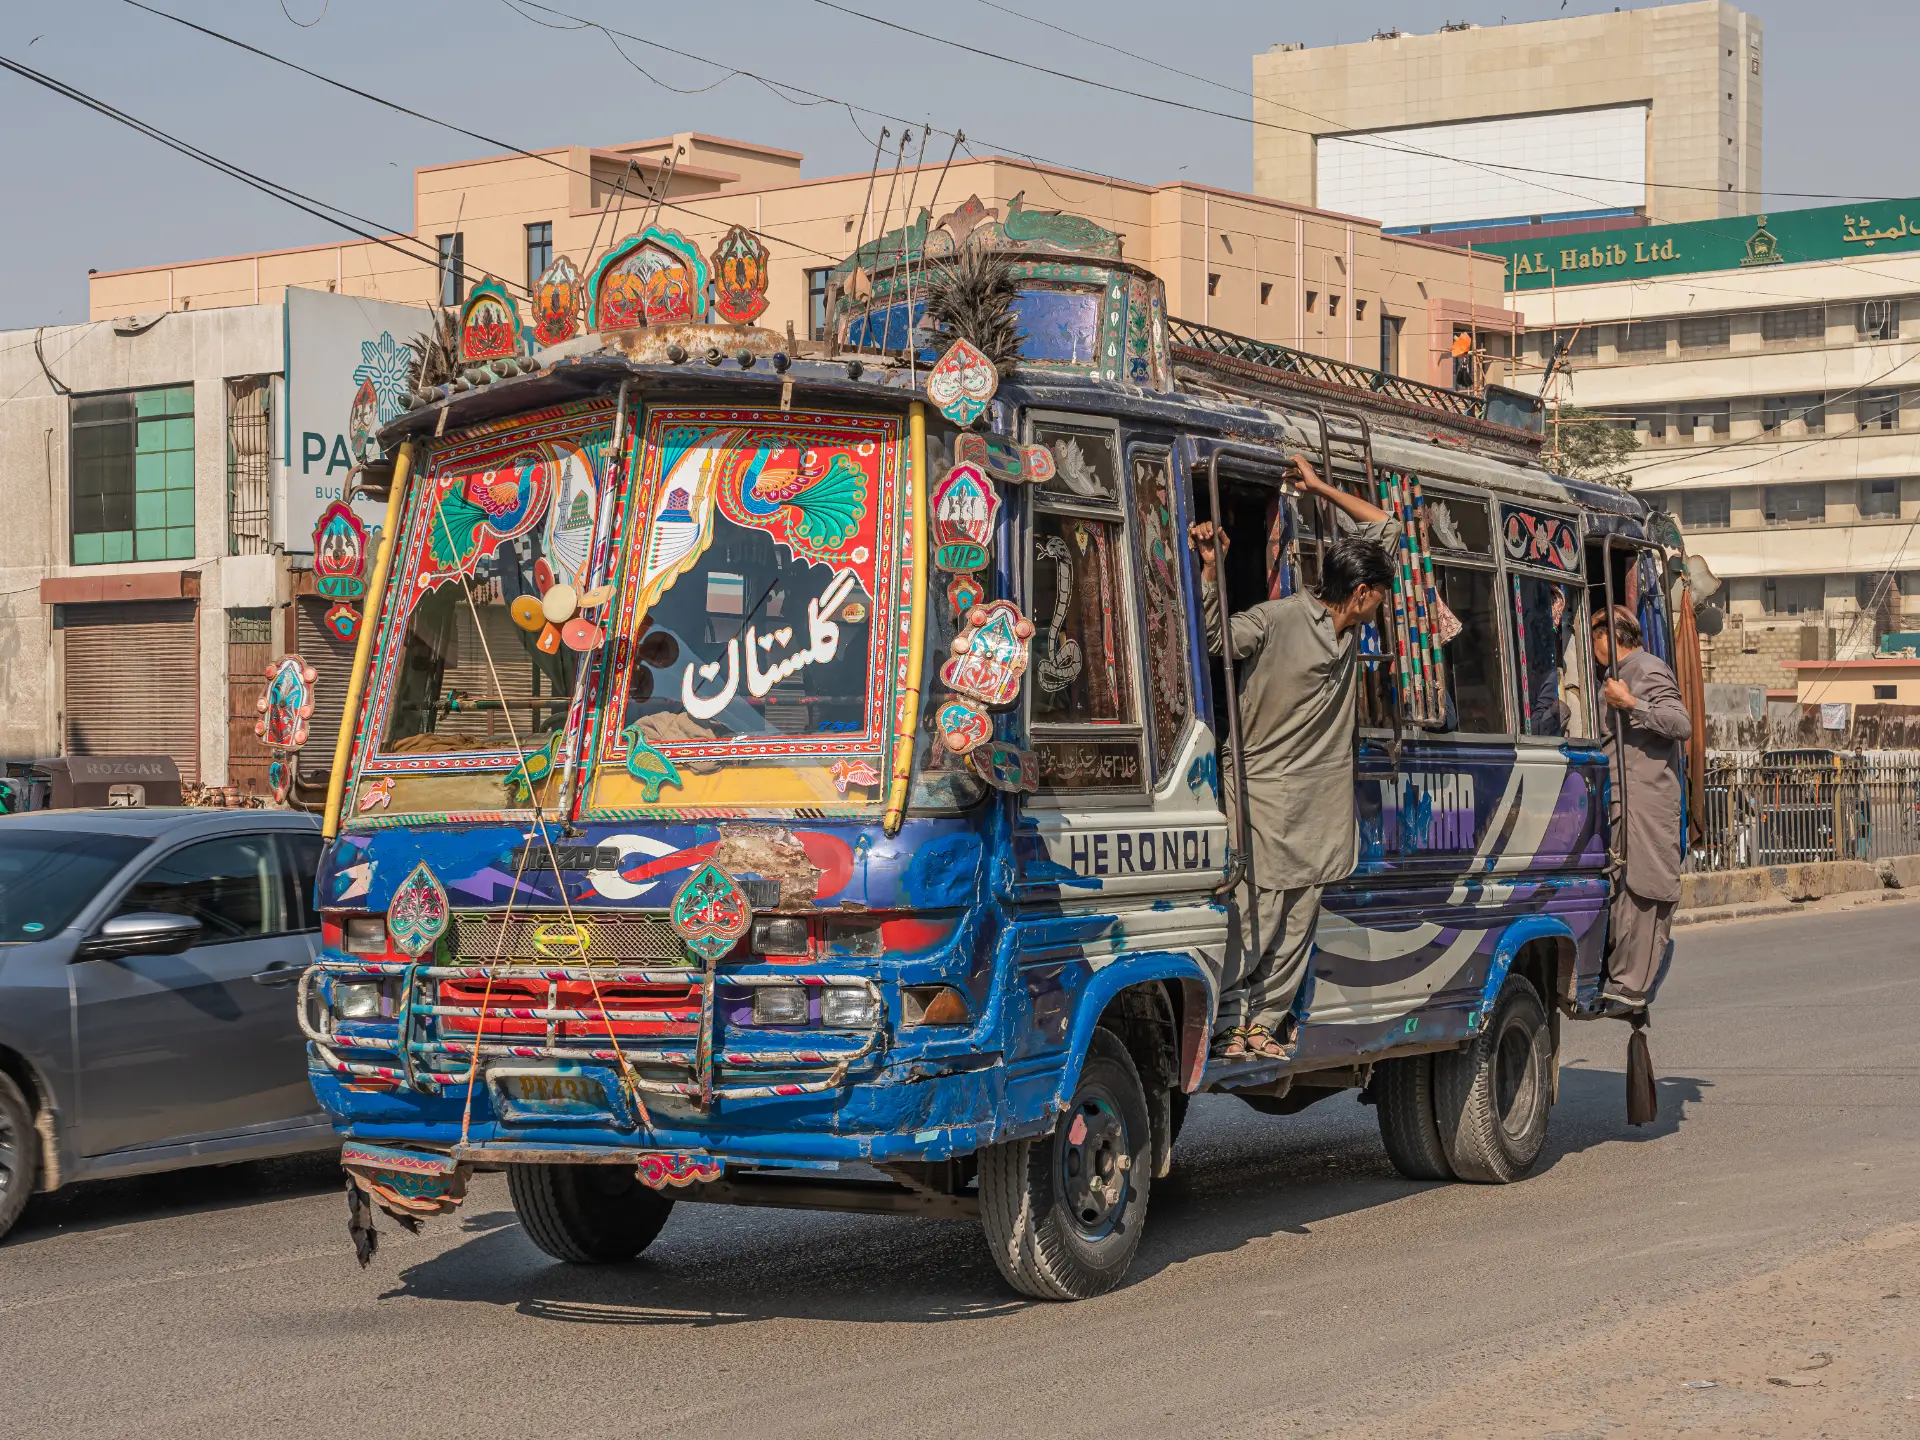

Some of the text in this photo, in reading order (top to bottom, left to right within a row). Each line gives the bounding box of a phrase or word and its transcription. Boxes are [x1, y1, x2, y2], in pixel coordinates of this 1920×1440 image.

[1516, 253, 1549, 275] AL
[1560, 243, 1627, 271] Habib
[1635, 238, 1681, 263] Ltd.
[943, 546, 981, 567] VIP
[321, 579, 360, 595] VIP
[681, 567, 856, 720] گلستان
[818, 720, 861, 733] 786
[86, 762, 164, 775] ROZGAR
